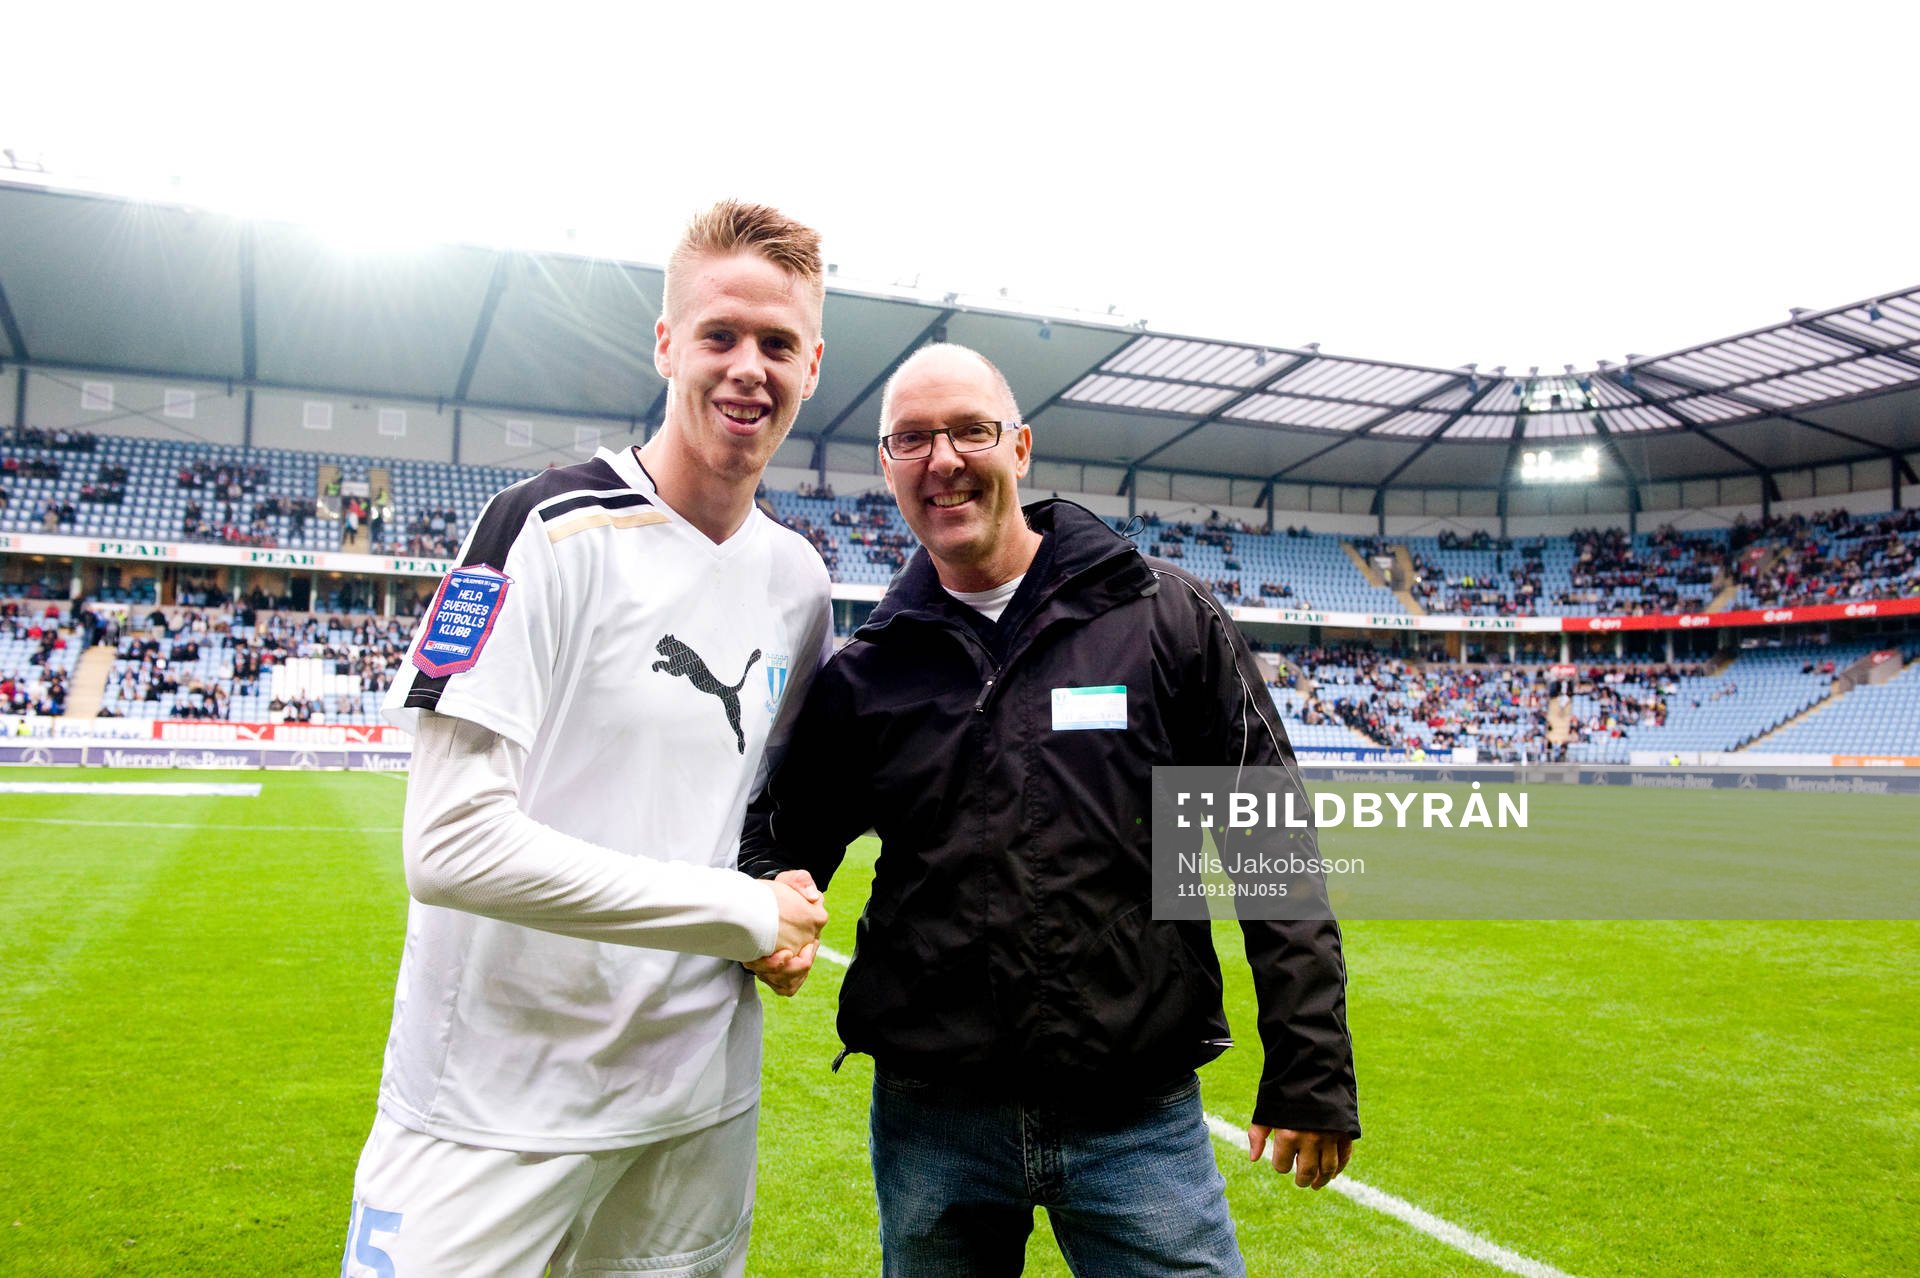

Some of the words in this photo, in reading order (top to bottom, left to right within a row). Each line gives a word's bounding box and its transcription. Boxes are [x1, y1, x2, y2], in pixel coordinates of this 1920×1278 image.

[98, 542, 167, 557] PEAB
[250, 551, 316, 566] PEAB
[458, 590, 483, 601] HELA
[442, 600, 490, 615] SVERIGES
[436, 611, 486, 628] FOTBOLLS
[439, 624, 472, 638] KLUBB
[103, 749, 248, 768] Mercedes-Benz
